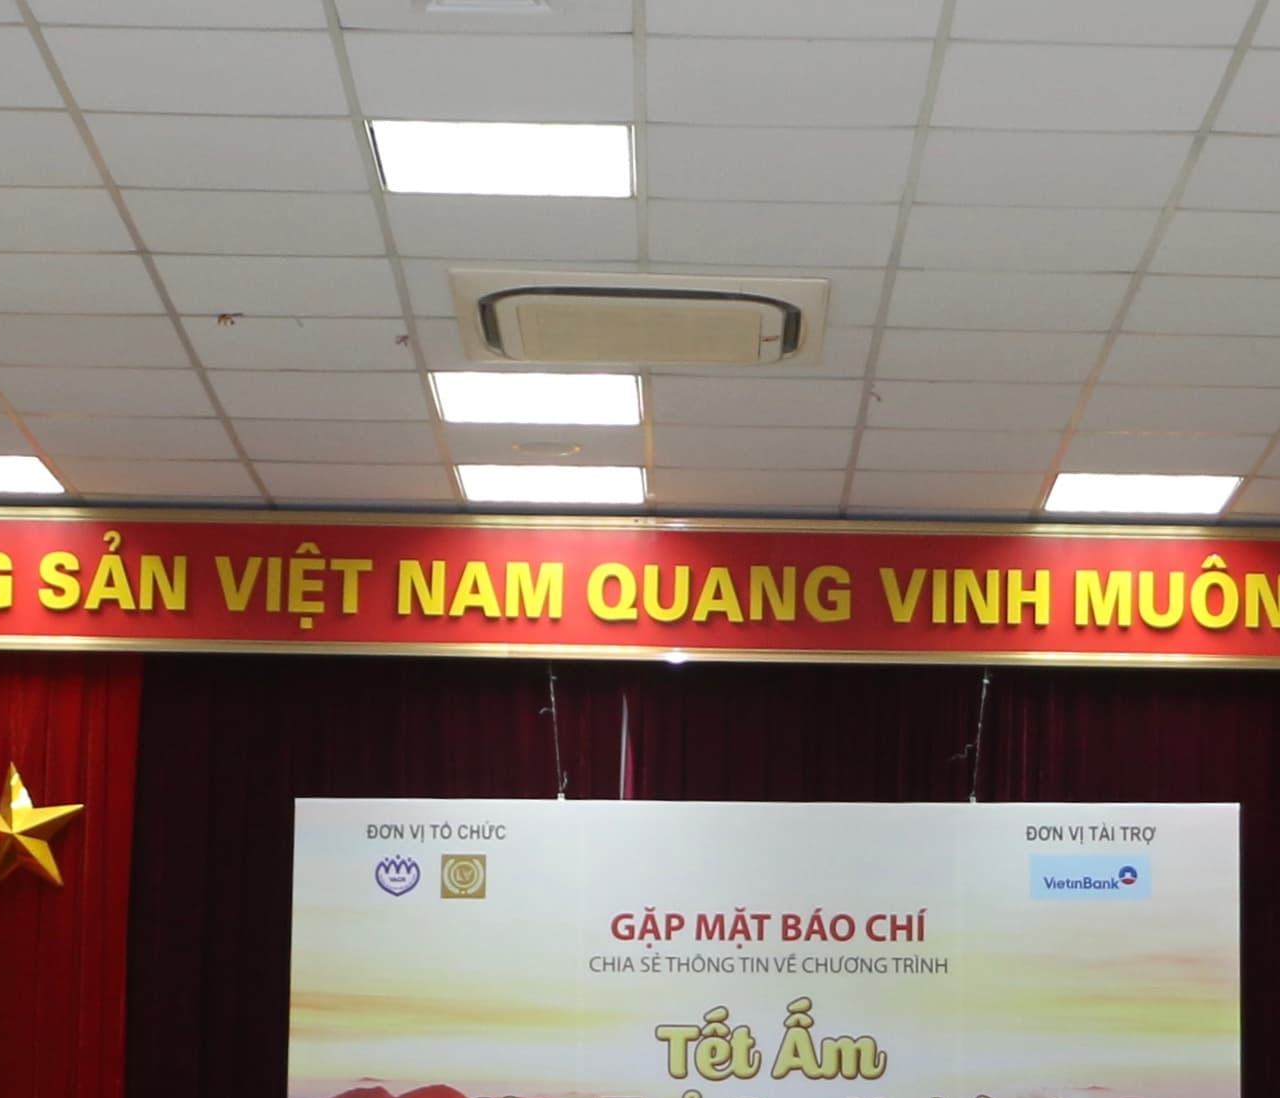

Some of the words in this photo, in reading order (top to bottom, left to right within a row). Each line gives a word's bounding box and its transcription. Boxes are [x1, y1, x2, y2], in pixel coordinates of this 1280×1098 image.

[38, 530, 187, 612] SẢN
[214, 542, 372, 630] VIỆT
[396, 558, 563, 620] NAM
[587, 562, 851, 625] QUANG
[879, 568, 1049, 627] VINH
[366, 824, 405, 840] ĐƠN
[410, 824, 425, 843] VỊ
[430, 820, 452, 840] TỔ
[457, 820, 506, 840] CHỨC
[1025, 826, 1063, 842] ĐƠN
[1068, 826, 1084, 845] VỊ
[1090, 822, 1115, 842] TÀI
[1119, 826, 1157, 846] TRỢ
[1044, 875, 1119, 890] VietinBank
[611, 907, 685, 949] GẶP
[695, 907, 771, 949] MẶT
[781, 908, 856, 942] BÁO
[865, 908, 928, 942] CHÍ
[589, 956, 634, 973] CHIA
[640, 952, 662, 973] SẺ
[666, 953, 735, 973] THÔNG
[741, 957, 769, 973] TIN
[773, 952, 797, 973] VỀ
[802, 956, 888, 974] CHƯƠNG
[892, 954, 949, 974] TRÌNH
[655, 1006, 761, 1081] Tết
[770, 997, 887, 1081] Ấm
